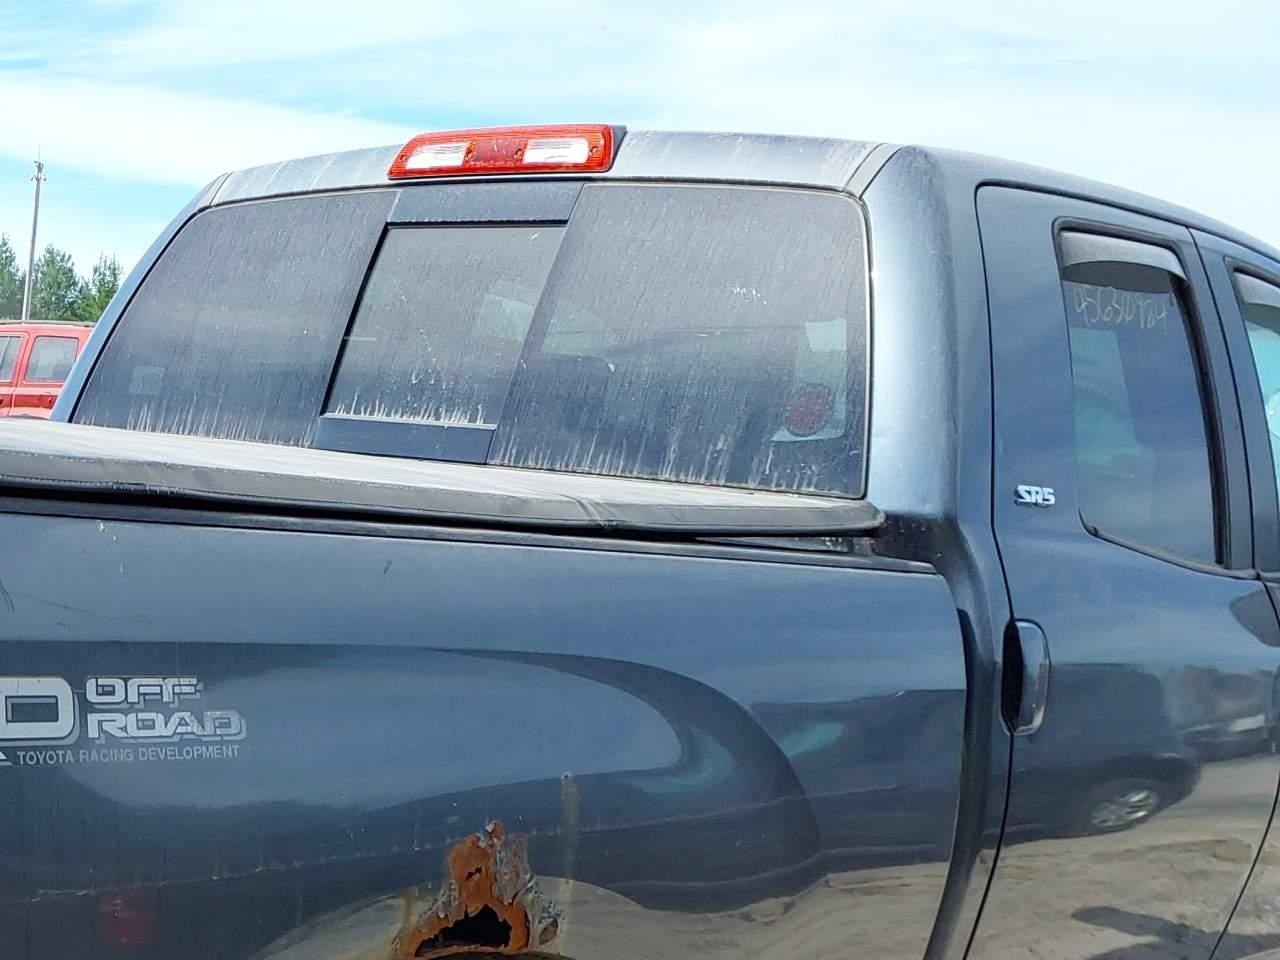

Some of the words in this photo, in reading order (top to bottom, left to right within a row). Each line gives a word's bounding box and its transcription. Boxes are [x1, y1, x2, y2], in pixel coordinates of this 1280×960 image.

[1017, 485, 1056, 505] SR5
[85, 676, 203, 709] OFF
[87, 711, 247, 745] ROAD
[17, 750, 74, 765] TOYOTA
[79, 748, 134, 763] RACING
[138, 744, 240, 761] DEVELOPMENT
